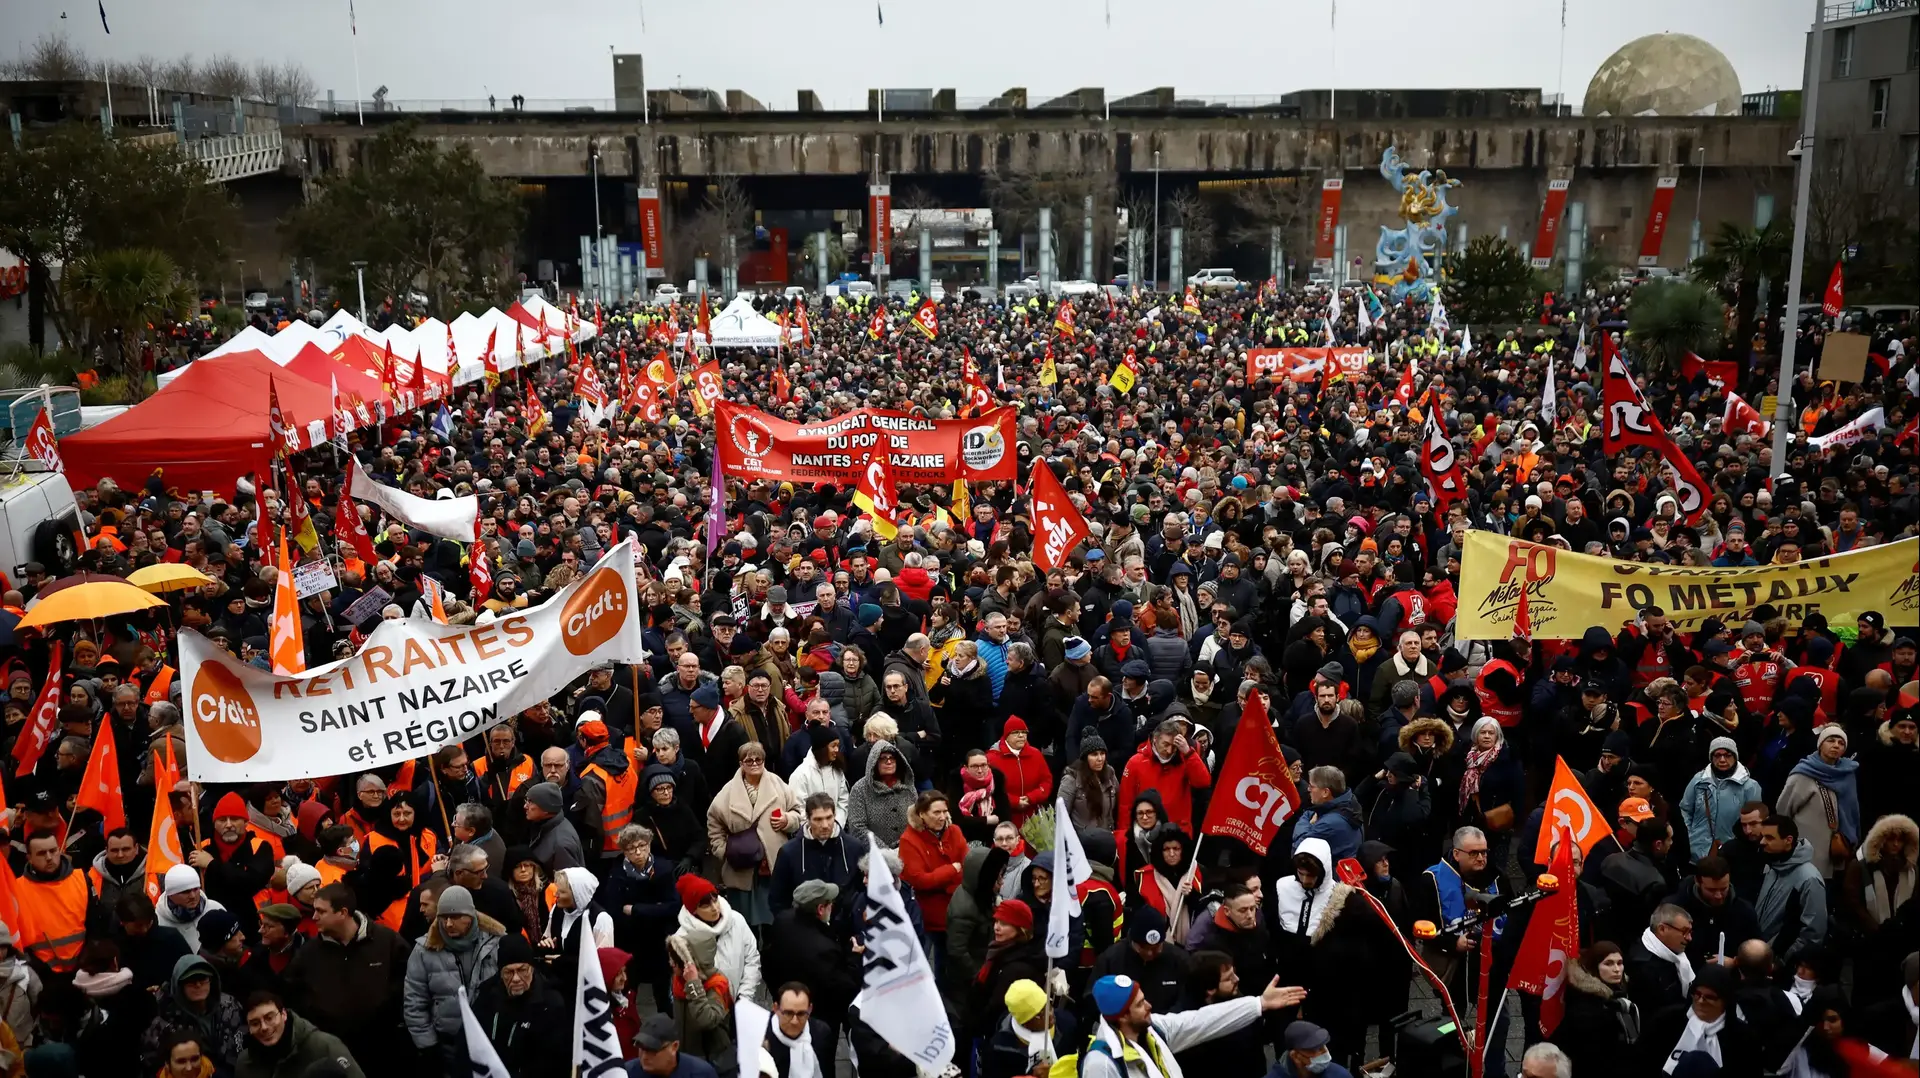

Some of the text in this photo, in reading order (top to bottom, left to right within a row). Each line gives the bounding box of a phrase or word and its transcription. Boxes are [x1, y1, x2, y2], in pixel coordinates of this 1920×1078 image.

[1255, 351, 1284, 372] cgt
[1341, 349, 1368, 371] cgt
[797, 415, 936, 436] SYNDICAT GENERAL
[827, 436, 848, 449] DU
[890, 435, 909, 448] DE
[743, 457, 763, 467] CGT
[791, 453, 851, 467] NANTES
[790, 468, 849, 478] FEDERATION
[1498, 541, 1557, 584] FO
[1600, 582, 1654, 611] FO
[1669, 573, 1860, 611] MÉTAUX
[298, 658, 530, 734] SAINT NAZAIRE
[196, 692, 259, 728] Cfdt:
[348, 702, 499, 764] et RÉGION
[1235, 776, 1295, 830] cgt
